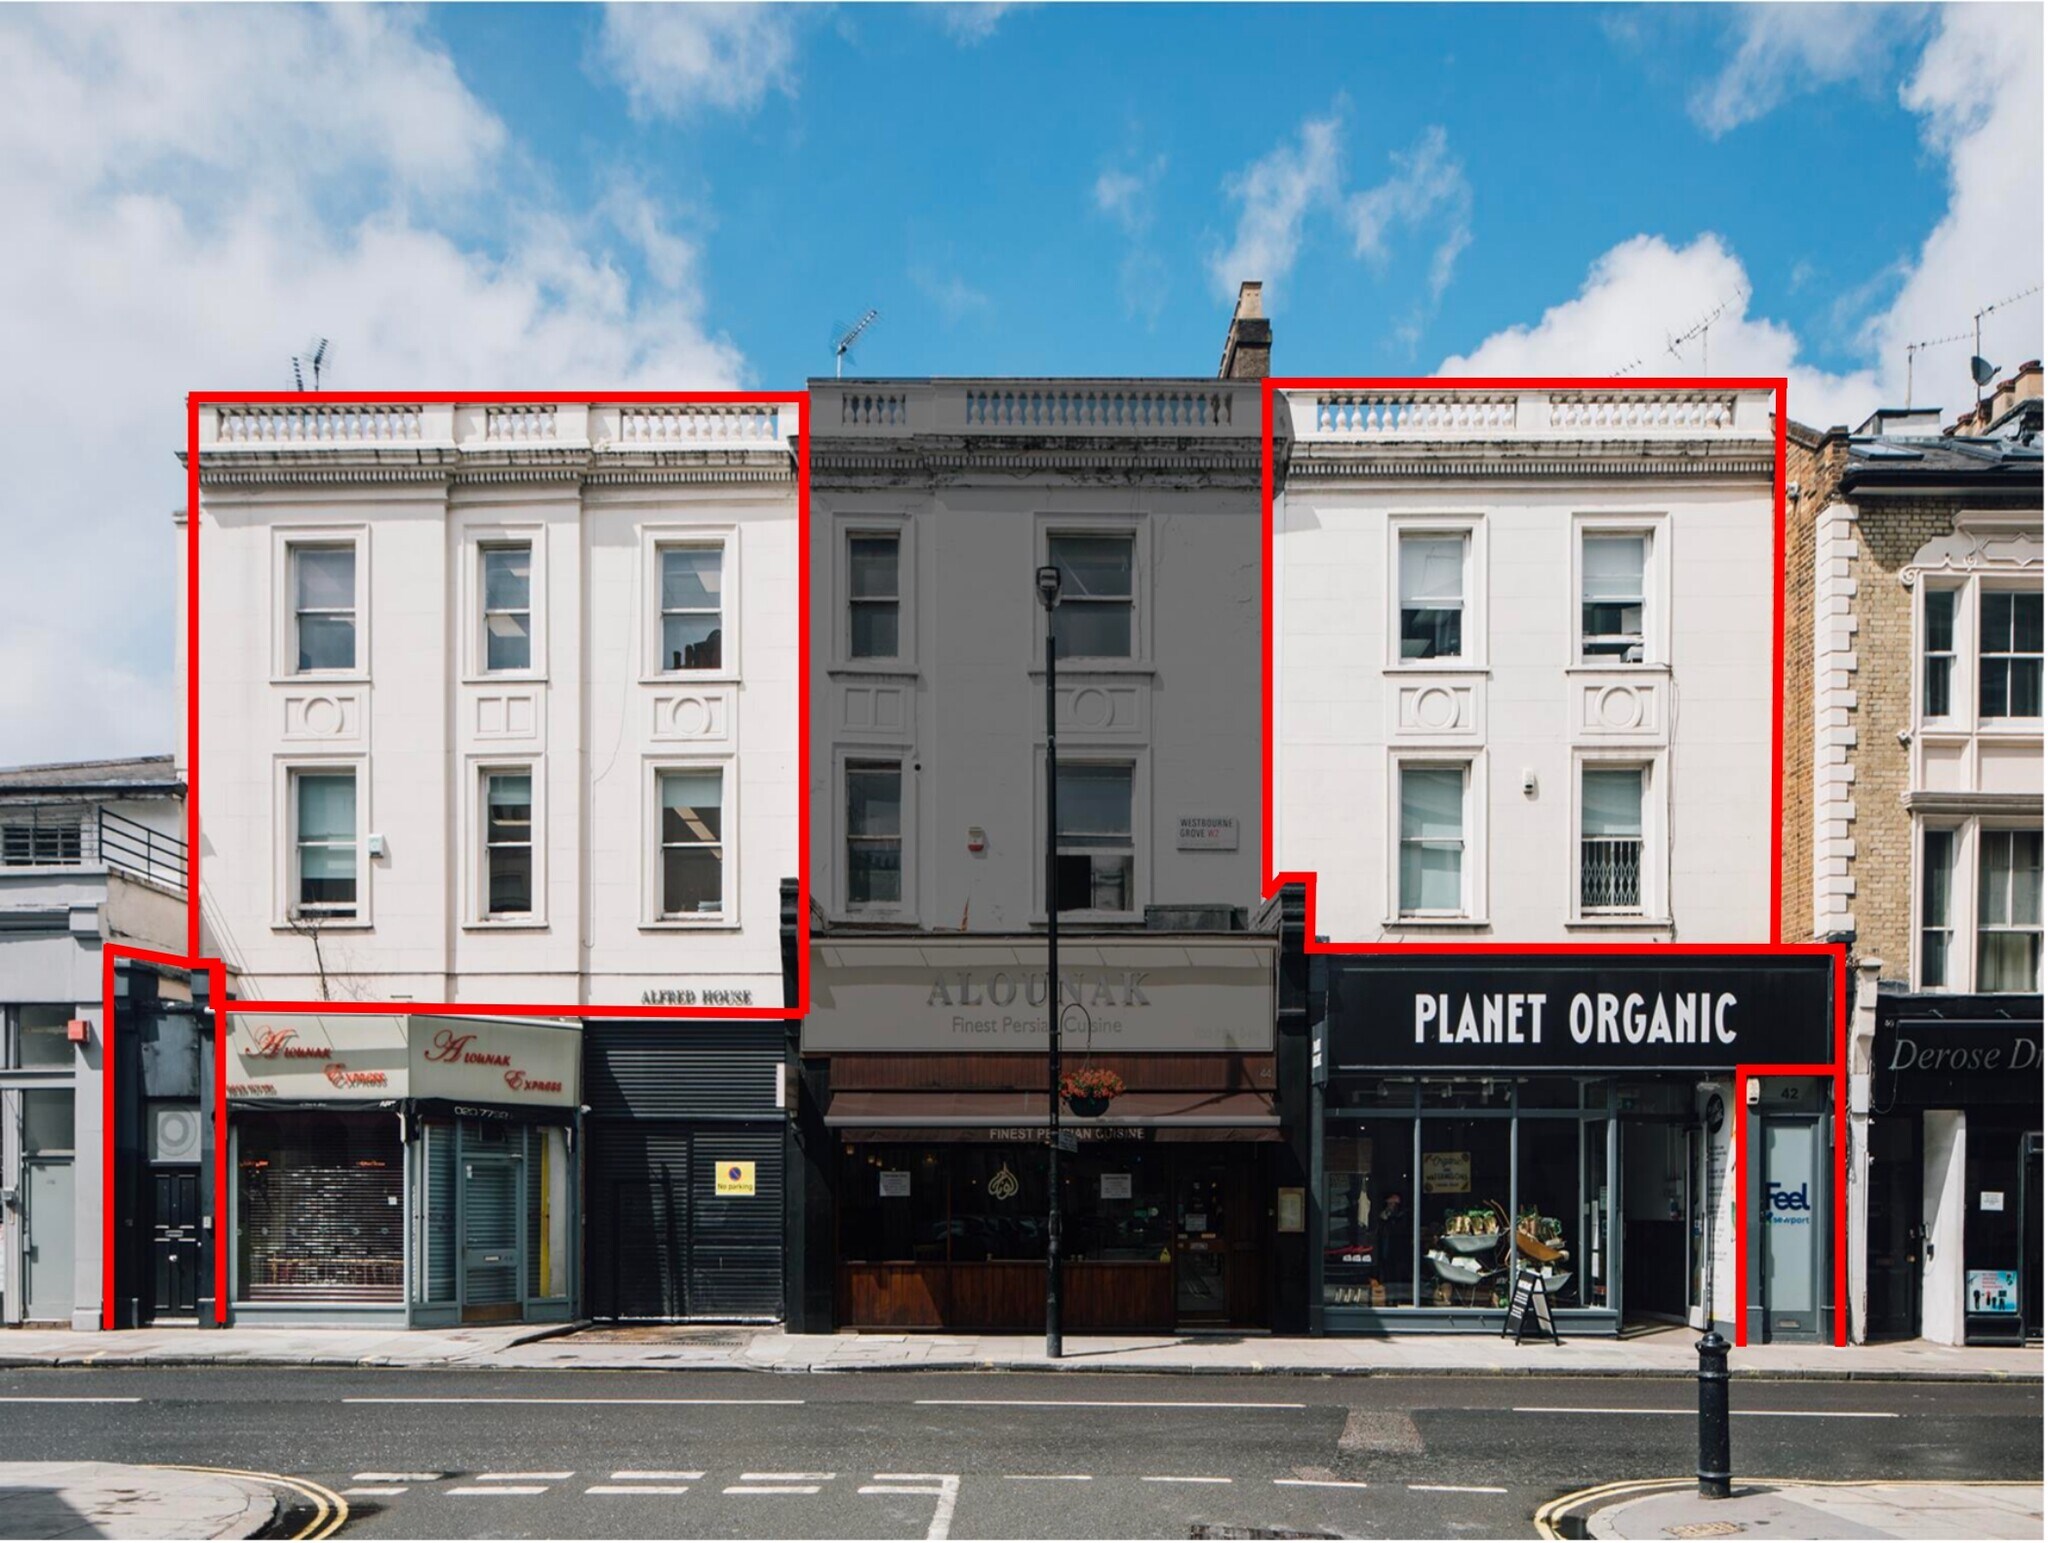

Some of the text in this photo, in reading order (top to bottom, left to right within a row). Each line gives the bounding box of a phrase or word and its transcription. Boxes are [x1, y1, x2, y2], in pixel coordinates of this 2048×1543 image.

[1180, 818, 1233, 827] WESTBOURNE
[1180, 829, 1219, 838] GROVE W2
[642, 989, 754, 1005] ALFRED HOUSE
[926, 972, 1152, 1007] ALOUNAK
[952, 1017, 997, 1033] Finest
[1002, 1017, 1048, 1033] Persia
[1415, 992, 1737, 1044] PLANET ORGANIC
[1888, 1039, 2001, 1070] Derose
[1781, 1088, 1799, 1100] 42
[989, 1128, 1034, 1140] FINEST
[1095, 1128, 1145, 1141] CUISINE
[728, 1183, 753, 1191] parking
[1765, 1182, 1810, 1211] Feel
